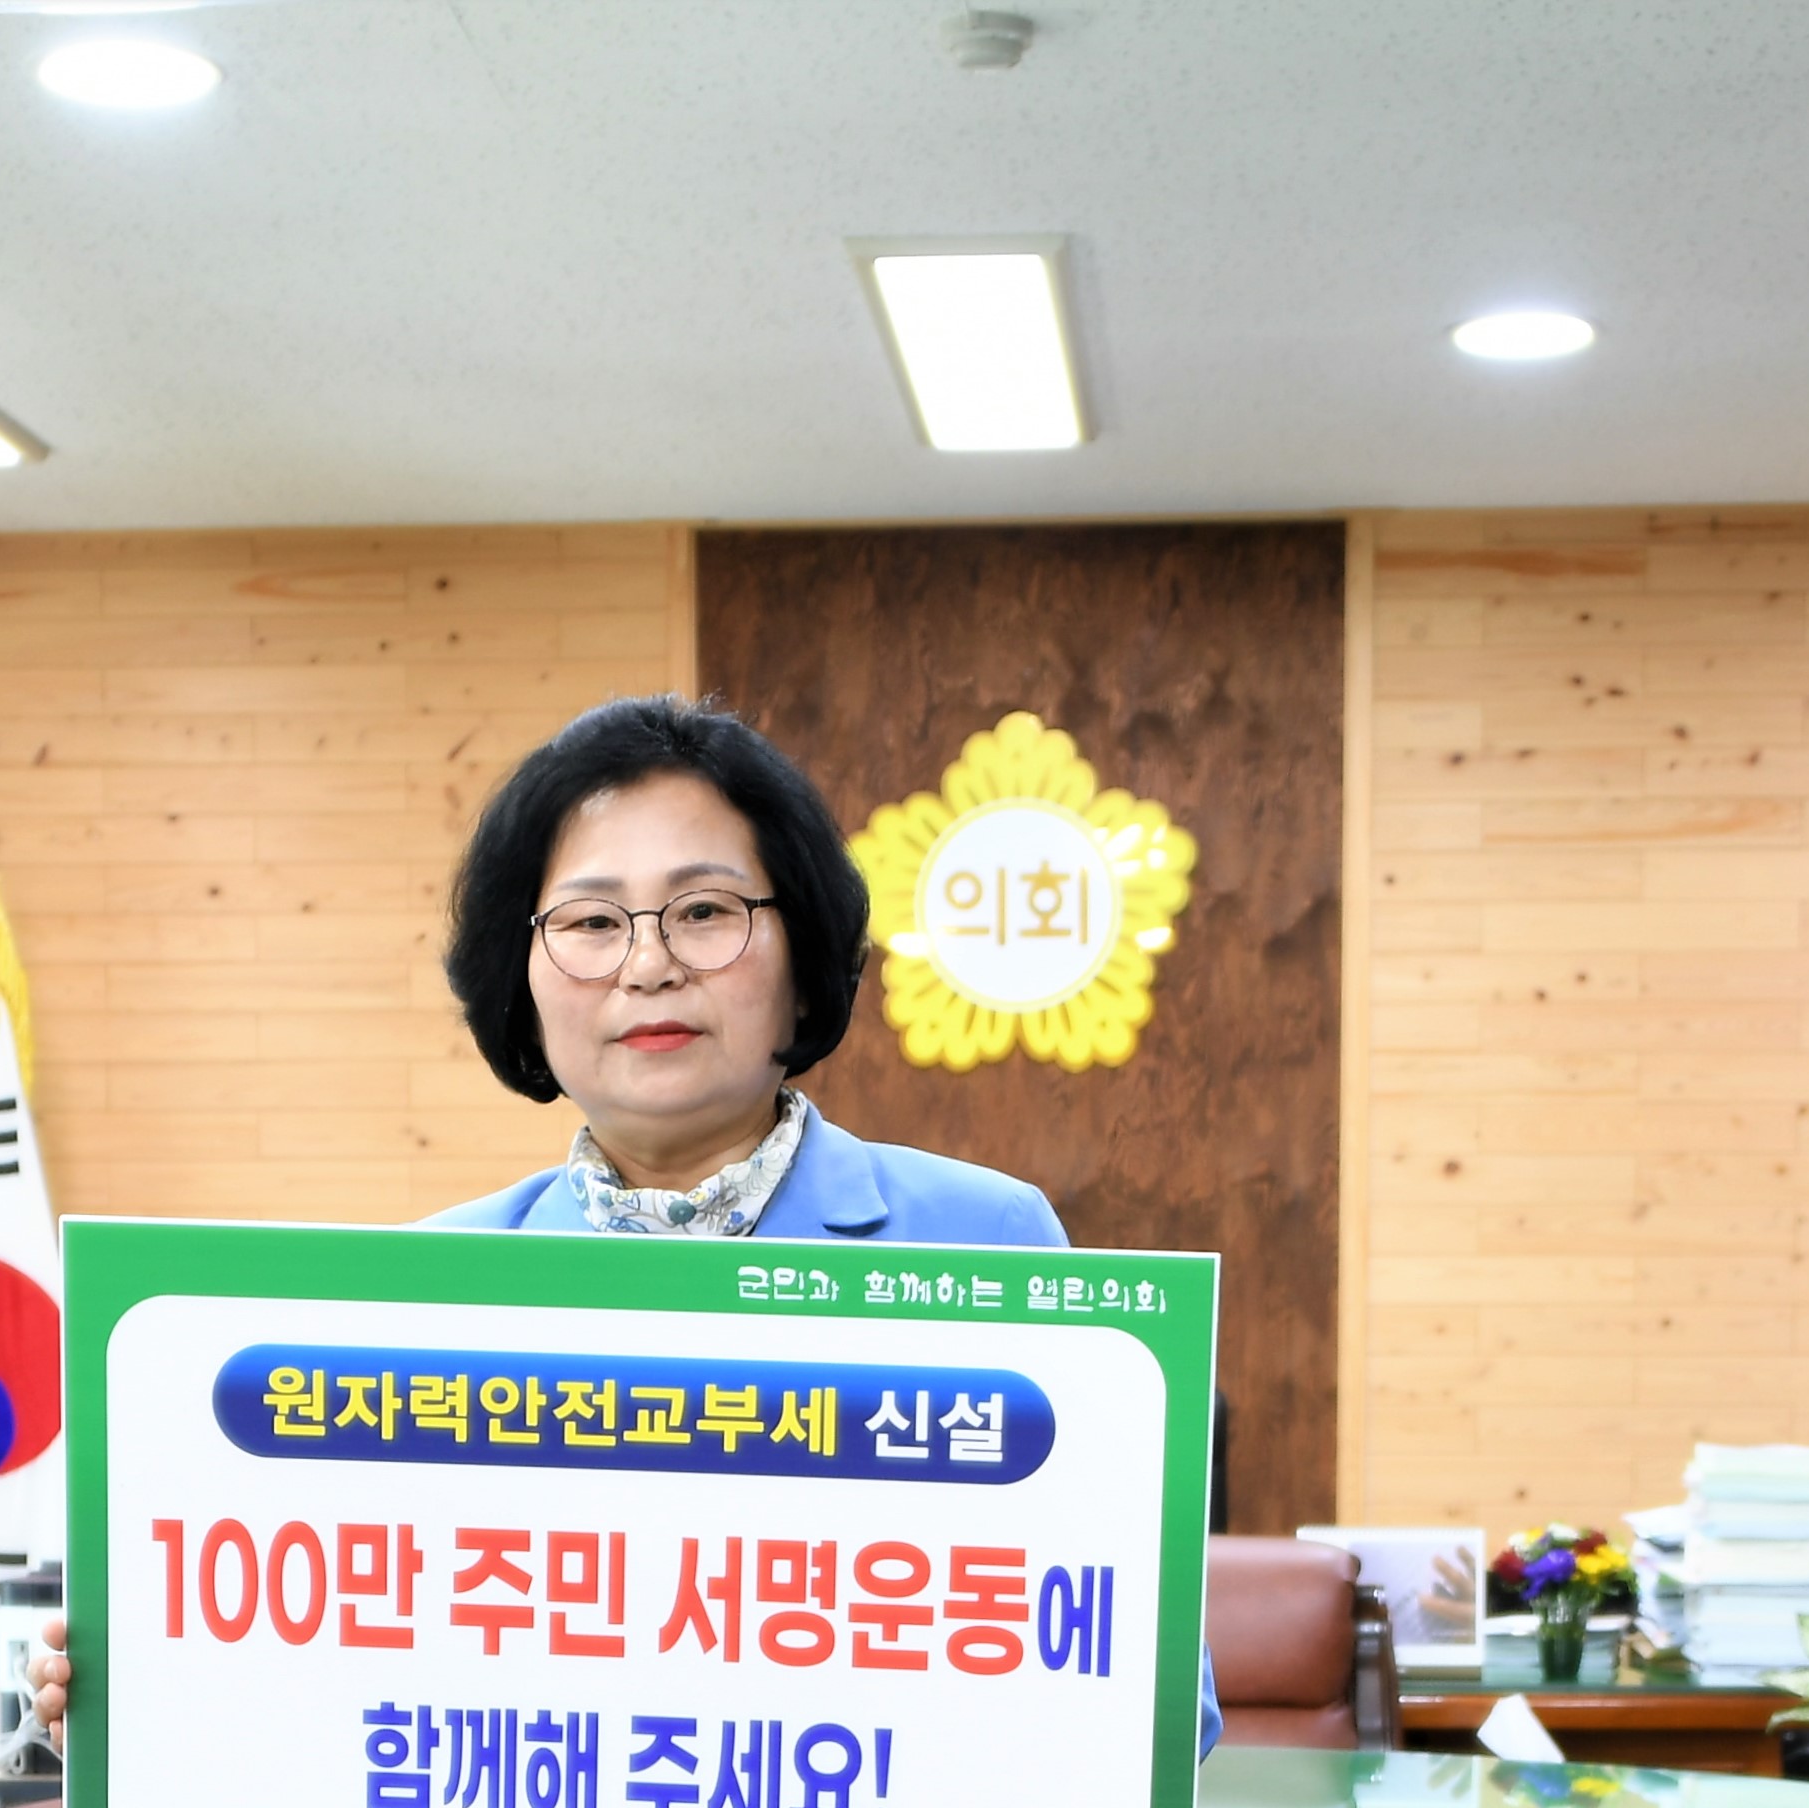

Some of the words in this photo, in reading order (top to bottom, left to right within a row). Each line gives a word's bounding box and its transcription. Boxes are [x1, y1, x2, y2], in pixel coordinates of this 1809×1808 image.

[942, 860, 1089, 946] 의회
[737, 1265, 840, 1302] 군민과
[864, 1270, 1003, 1308] 함께하는
[1027, 1275, 1167, 1314] 열린의회
[264, 1367, 837, 1456] 원자력안전교부세
[863, 1389, 1005, 1464] 신설
[152, 1518, 424, 1649] 100만
[450, 1527, 626, 1658] 주민
[659, 1536, 1115, 1678] 서명운동에
